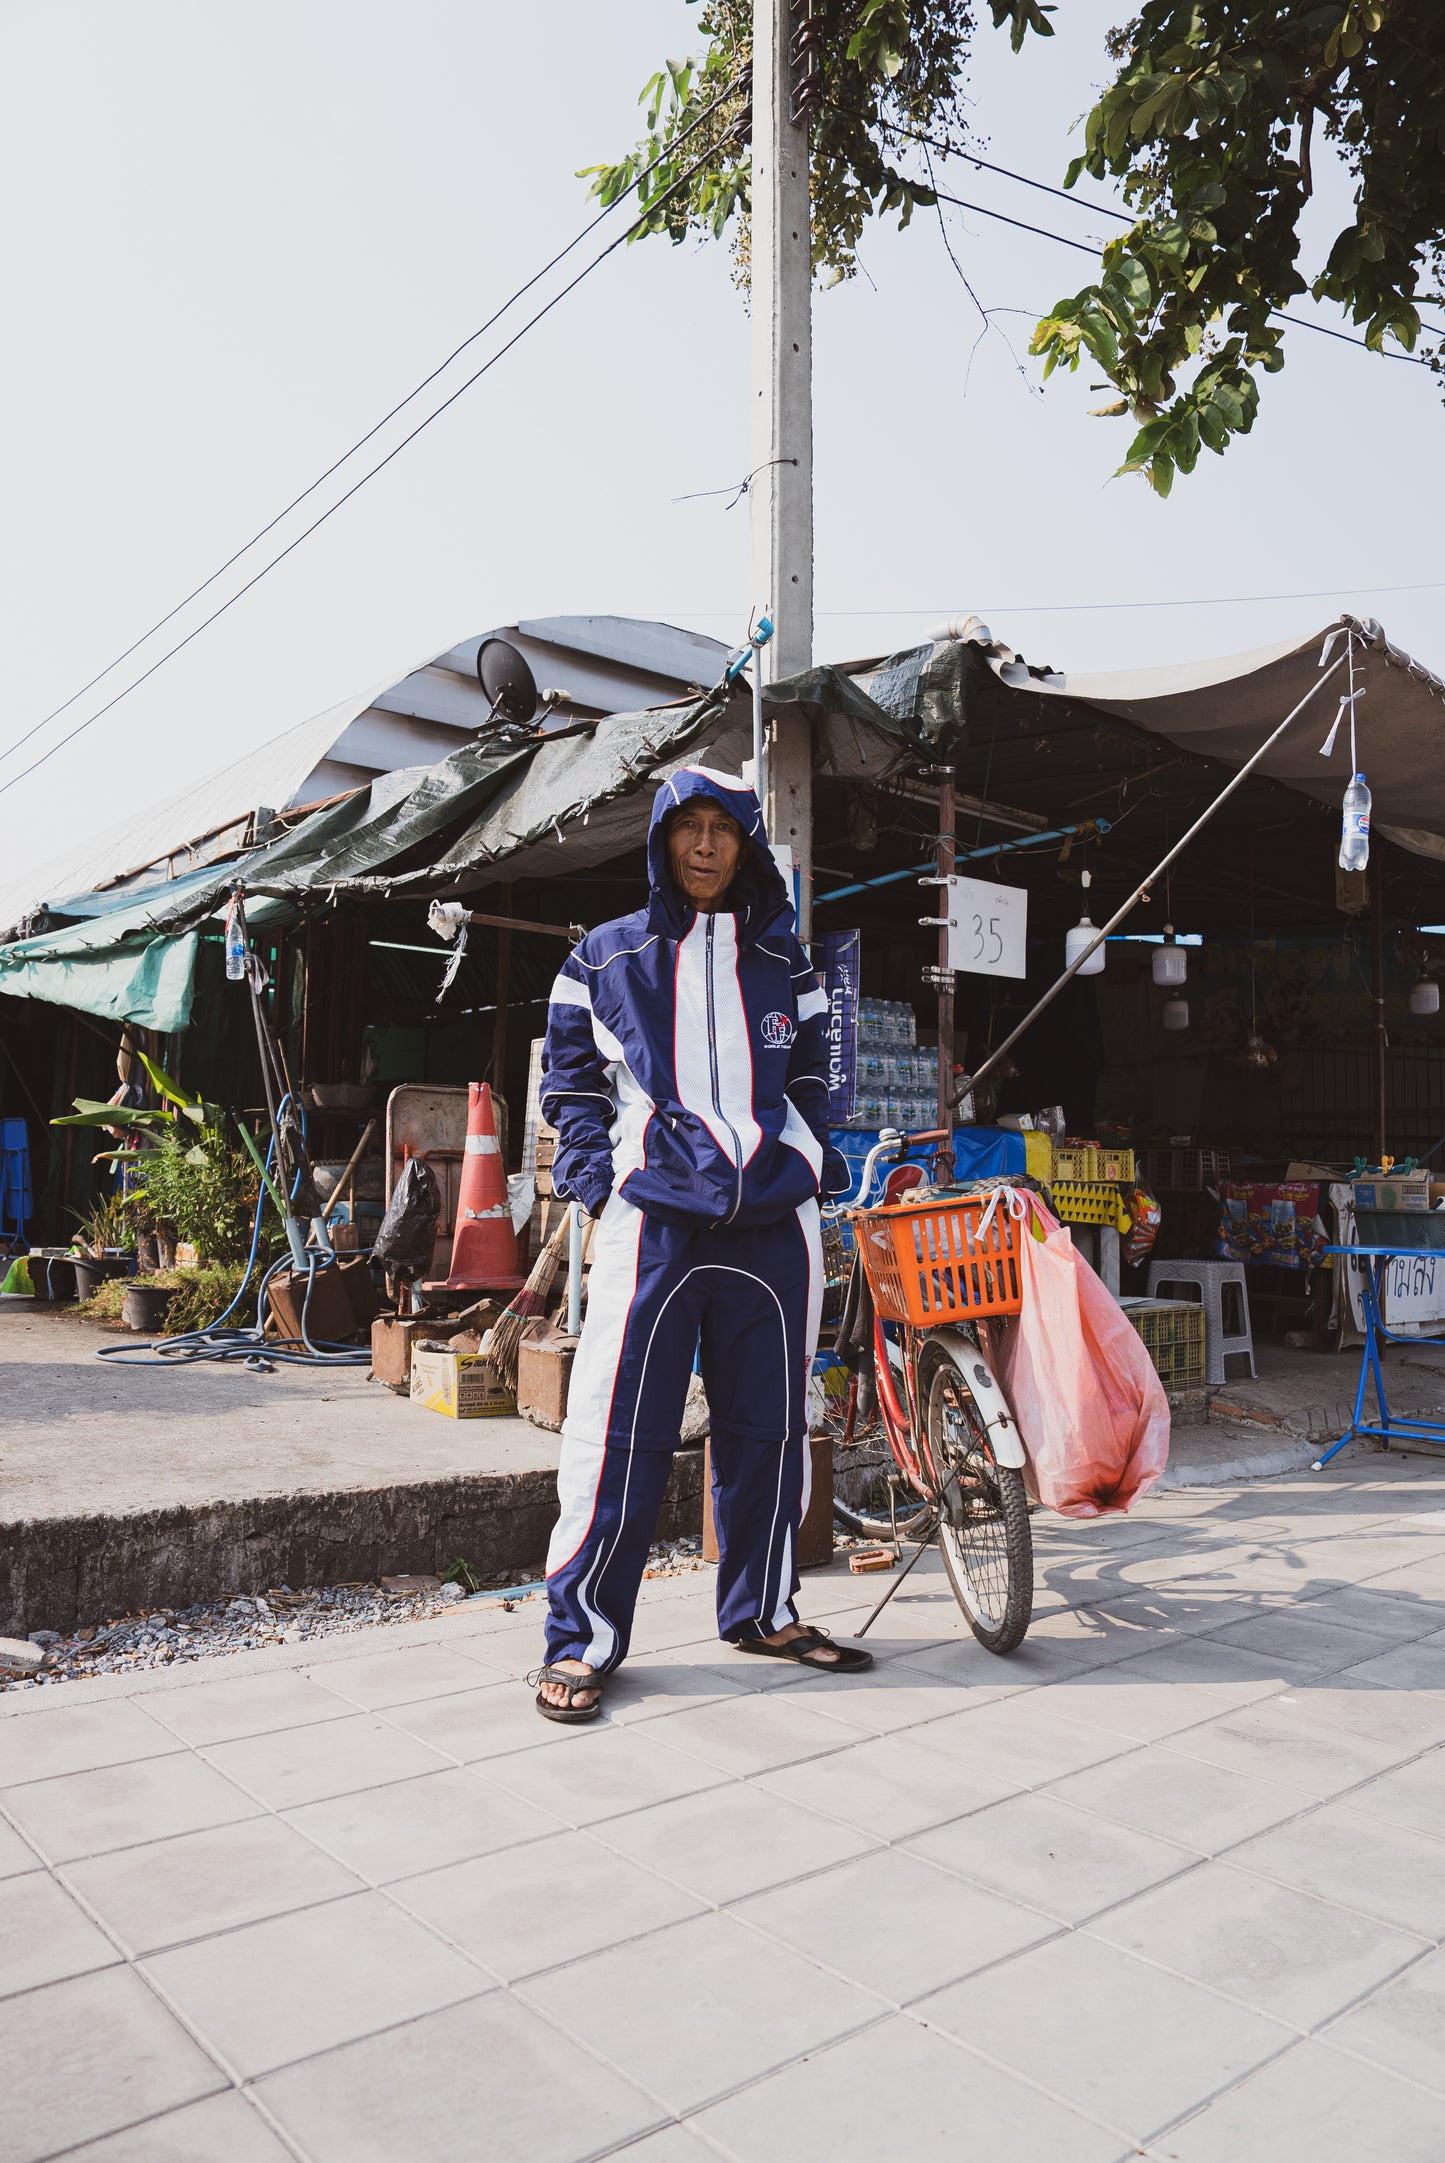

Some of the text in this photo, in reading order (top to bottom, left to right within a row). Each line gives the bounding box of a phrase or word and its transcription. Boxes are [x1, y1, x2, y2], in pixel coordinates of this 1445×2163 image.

[972, 914, 1003, 963] 35
[822, 988, 847, 1092] พูดแล้วทำ
